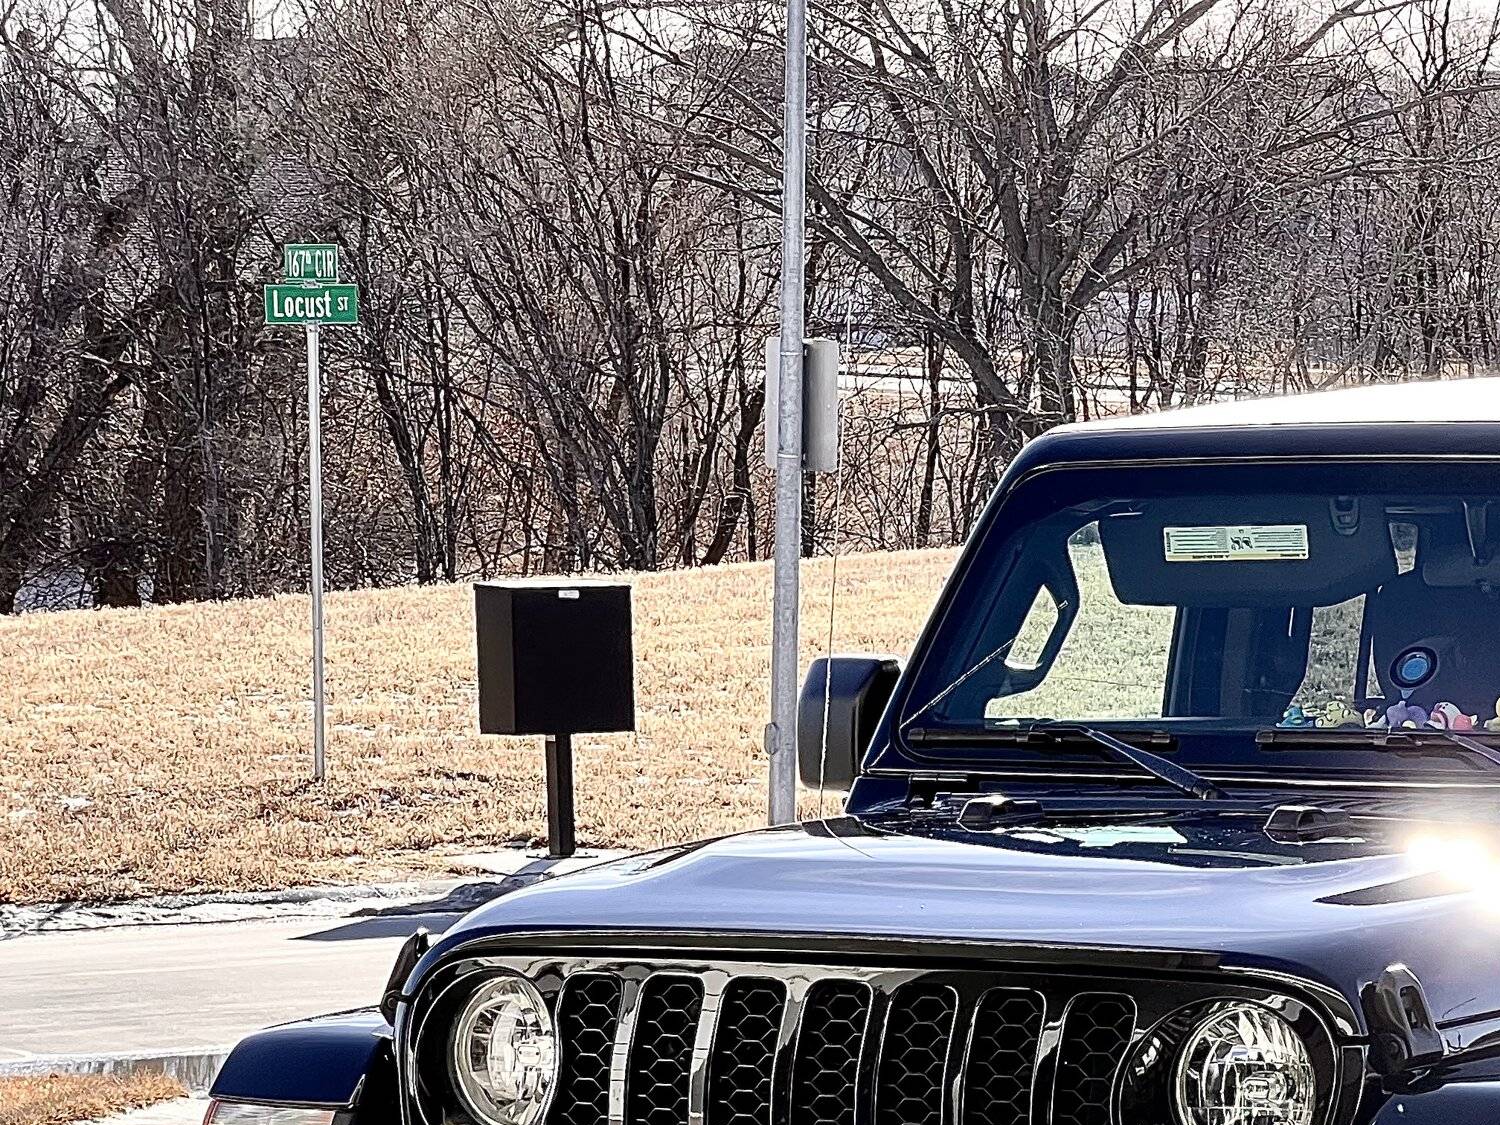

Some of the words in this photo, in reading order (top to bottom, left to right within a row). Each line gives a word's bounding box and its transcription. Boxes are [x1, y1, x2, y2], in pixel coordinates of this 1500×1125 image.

[314, 249, 335, 278] CIR
[272, 289, 332, 318] Locust
[337, 296, 349, 311] ST
